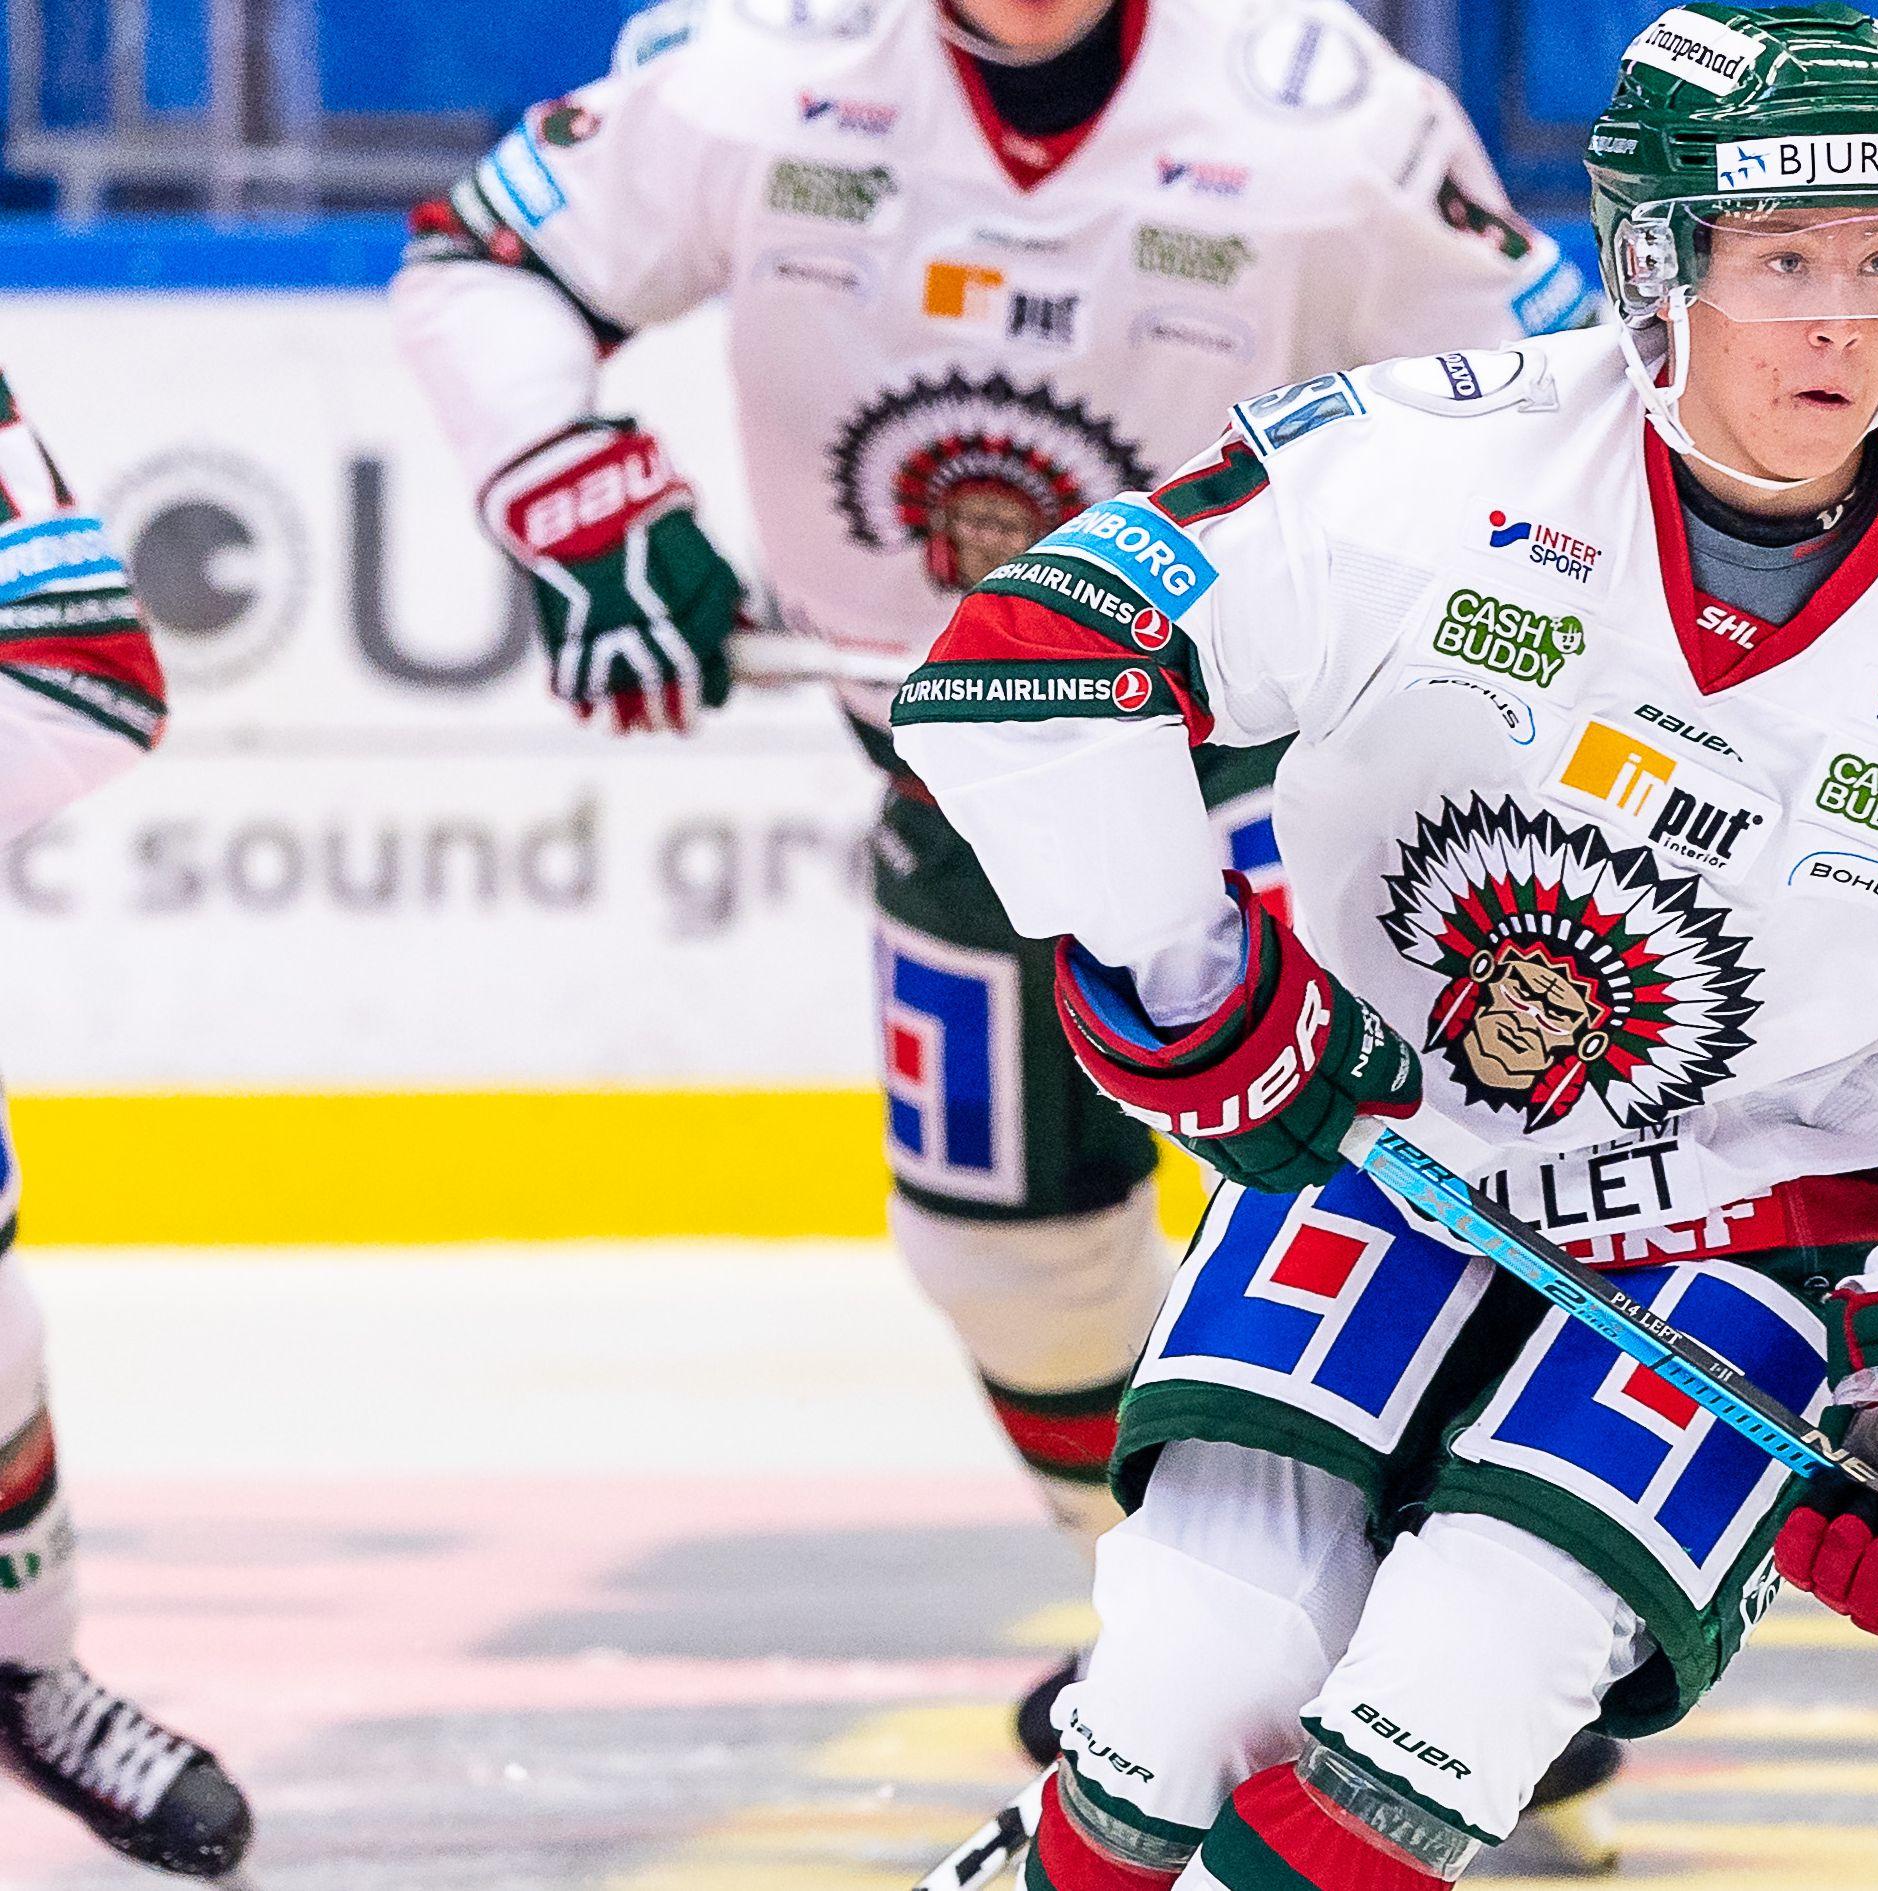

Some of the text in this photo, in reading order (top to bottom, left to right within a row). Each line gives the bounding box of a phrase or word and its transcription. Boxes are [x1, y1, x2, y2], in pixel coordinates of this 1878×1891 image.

[1064, 511, 1197, 597] ENBORG
[1529, 544, 1593, 584] SPORT
[1535, 524, 1597, 566] INTER
[1450, 594, 1548, 647] CASH
[1696, 604, 1760, 650] SHL
[1437, 621, 1562, 685] BUDDY
[899, 678, 1112, 705] TURKISH AIRLINES
[130, 785, 606, 915] sound
[1640, 1312, 1683, 1345] LEFT
[1350, 1702, 1473, 1781] BAUER
